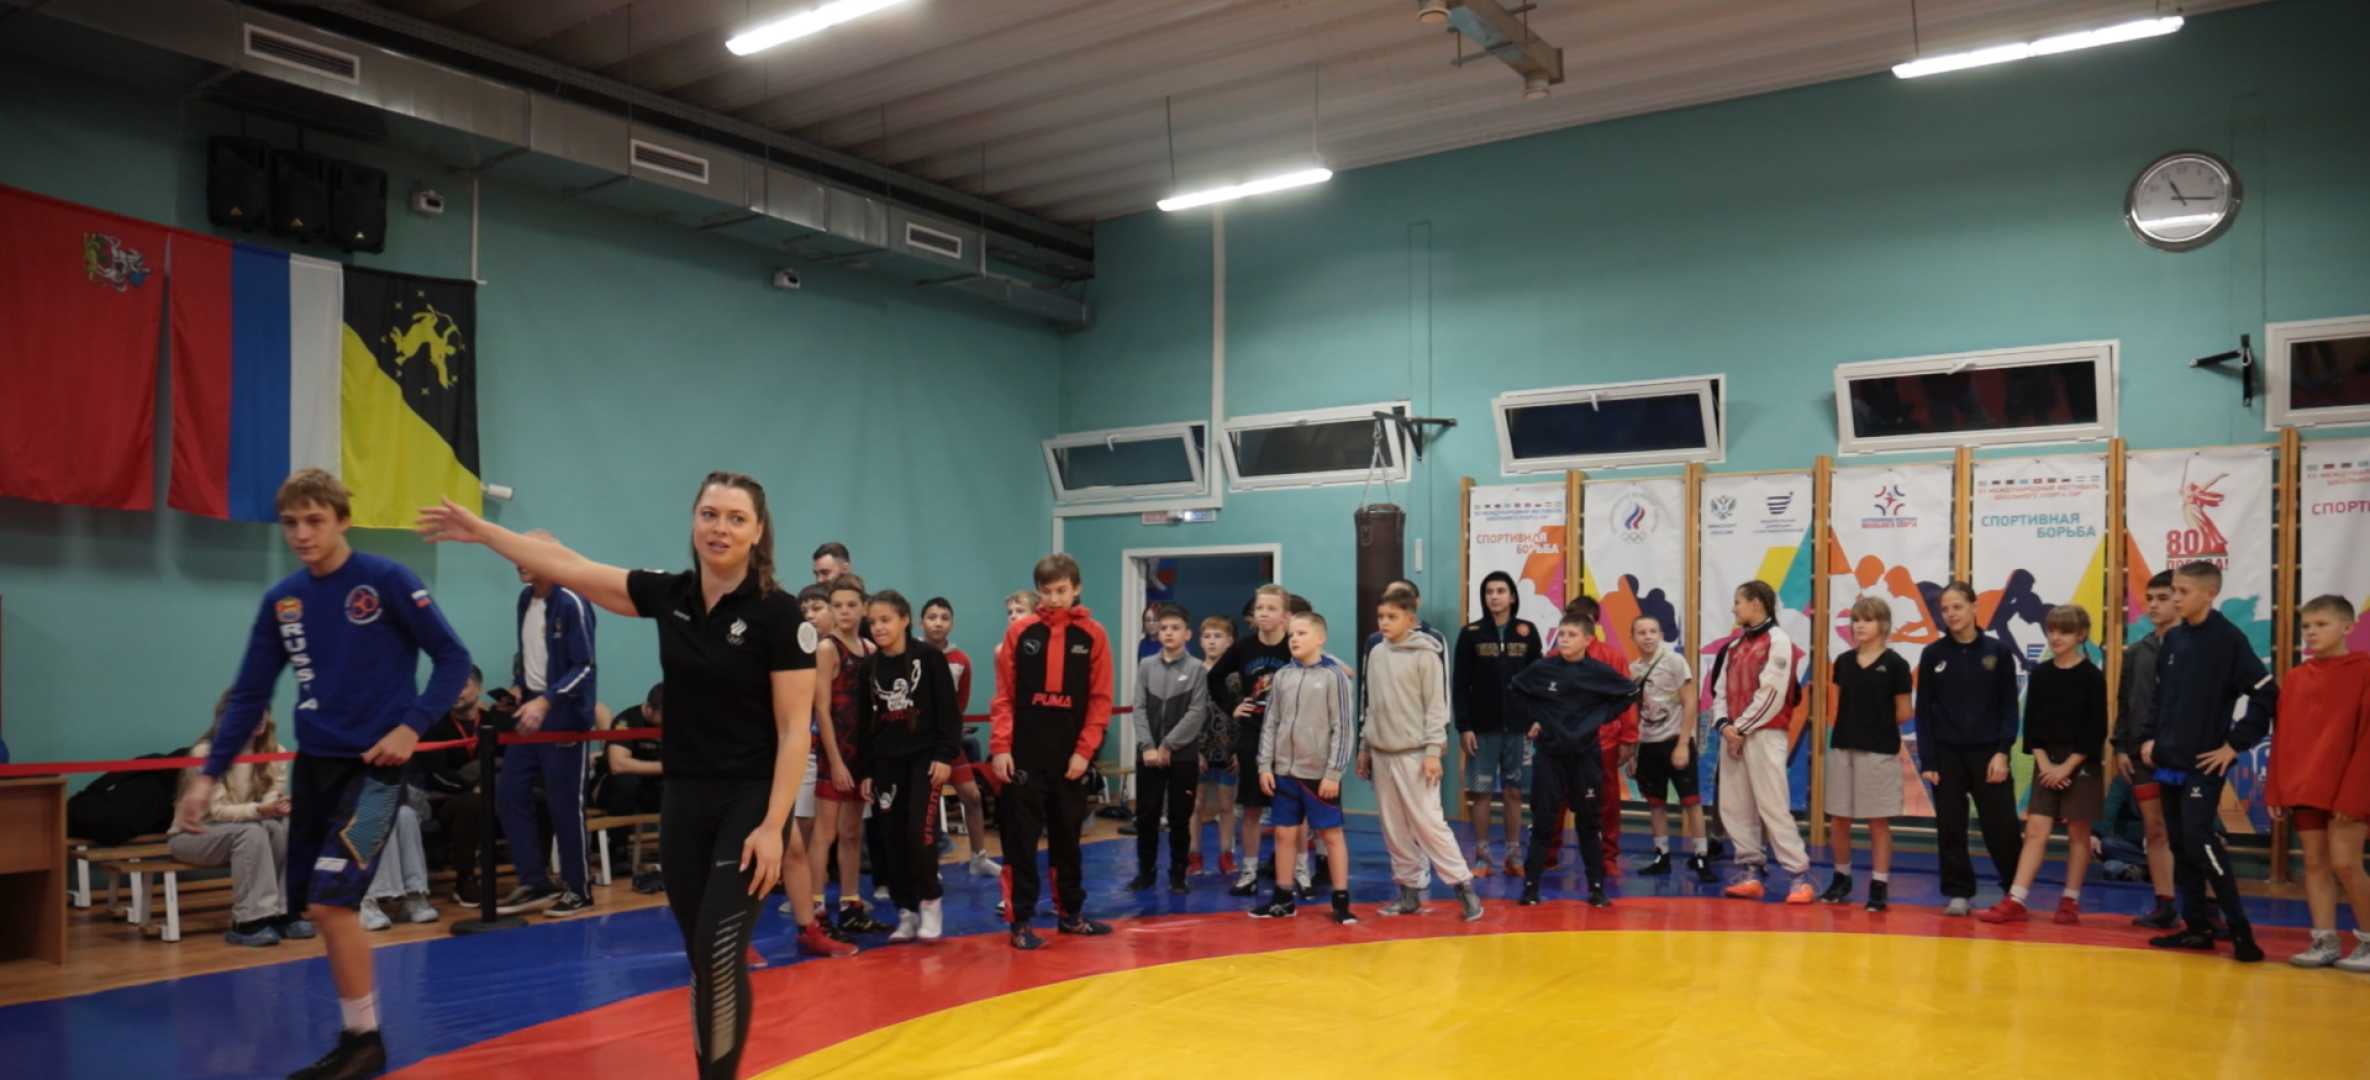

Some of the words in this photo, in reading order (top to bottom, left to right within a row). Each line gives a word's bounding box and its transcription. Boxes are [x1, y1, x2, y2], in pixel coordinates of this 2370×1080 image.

[1981, 512, 2080, 527] СПОРТИВНАЯ
[1476, 532, 1549, 544] СПОРТИВНАЯ
[2036, 526, 2097, 538] БОРЬБА
[2167, 529, 2199, 555] 80
[1031, 693, 1072, 708] PUMA
